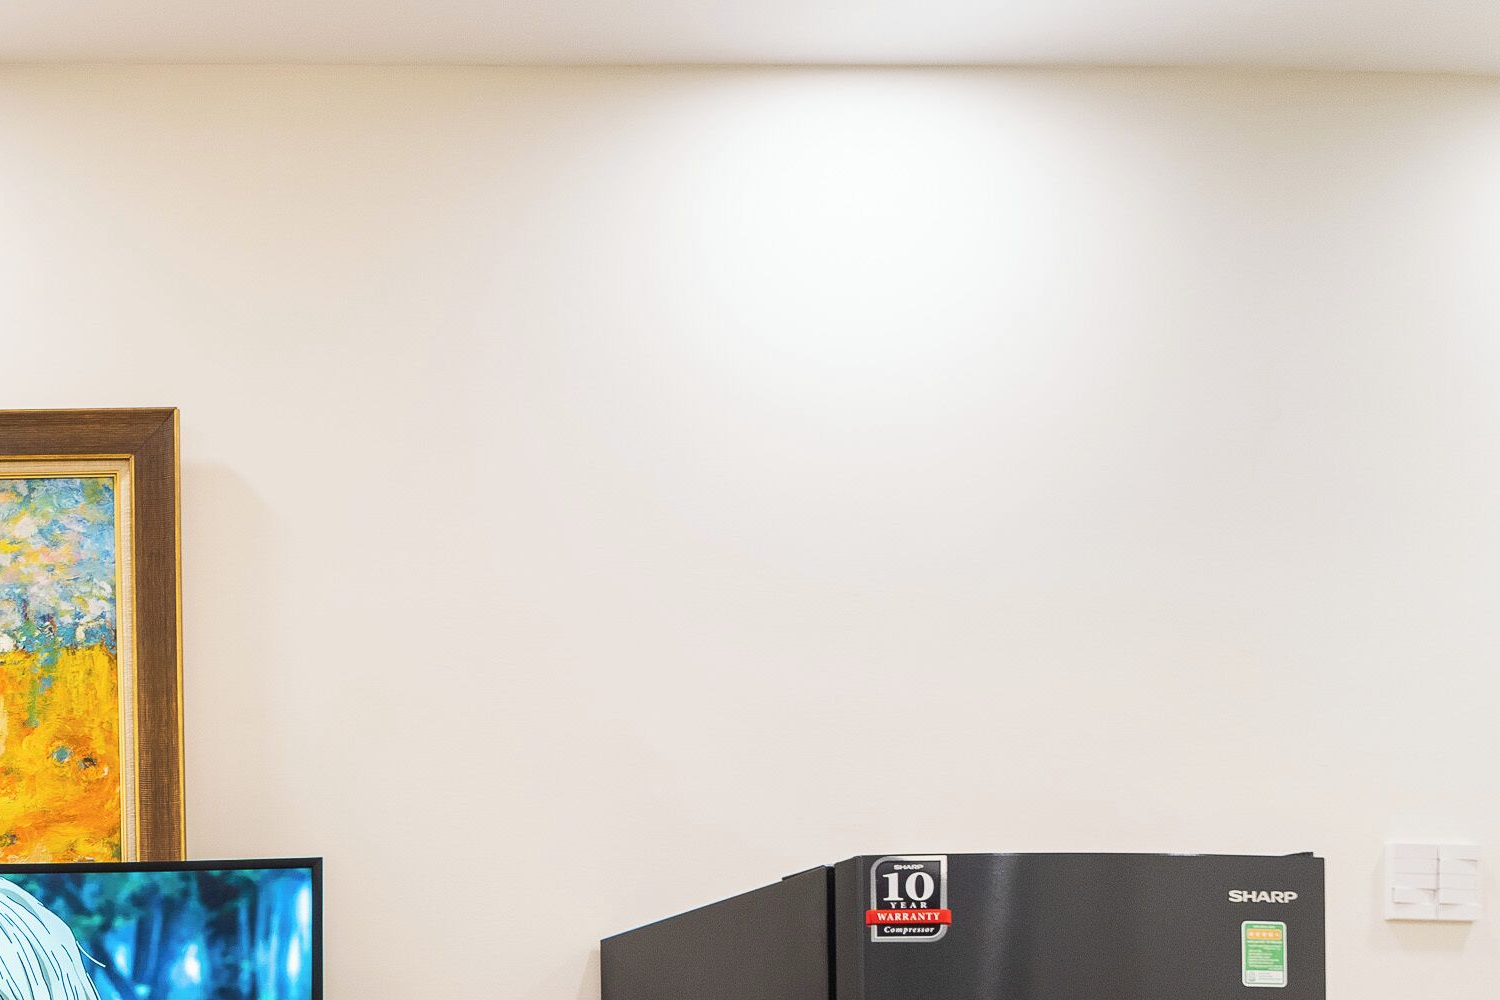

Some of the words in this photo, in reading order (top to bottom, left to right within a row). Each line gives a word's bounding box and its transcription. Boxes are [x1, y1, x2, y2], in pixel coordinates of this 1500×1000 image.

[882, 871, 935, 902] 10
[1227, 889, 1299, 904] SHARP
[890, 901, 928, 909] YEAR
[876, 912, 941, 921] WARRANTY
[883, 925, 935, 935] Compressor
